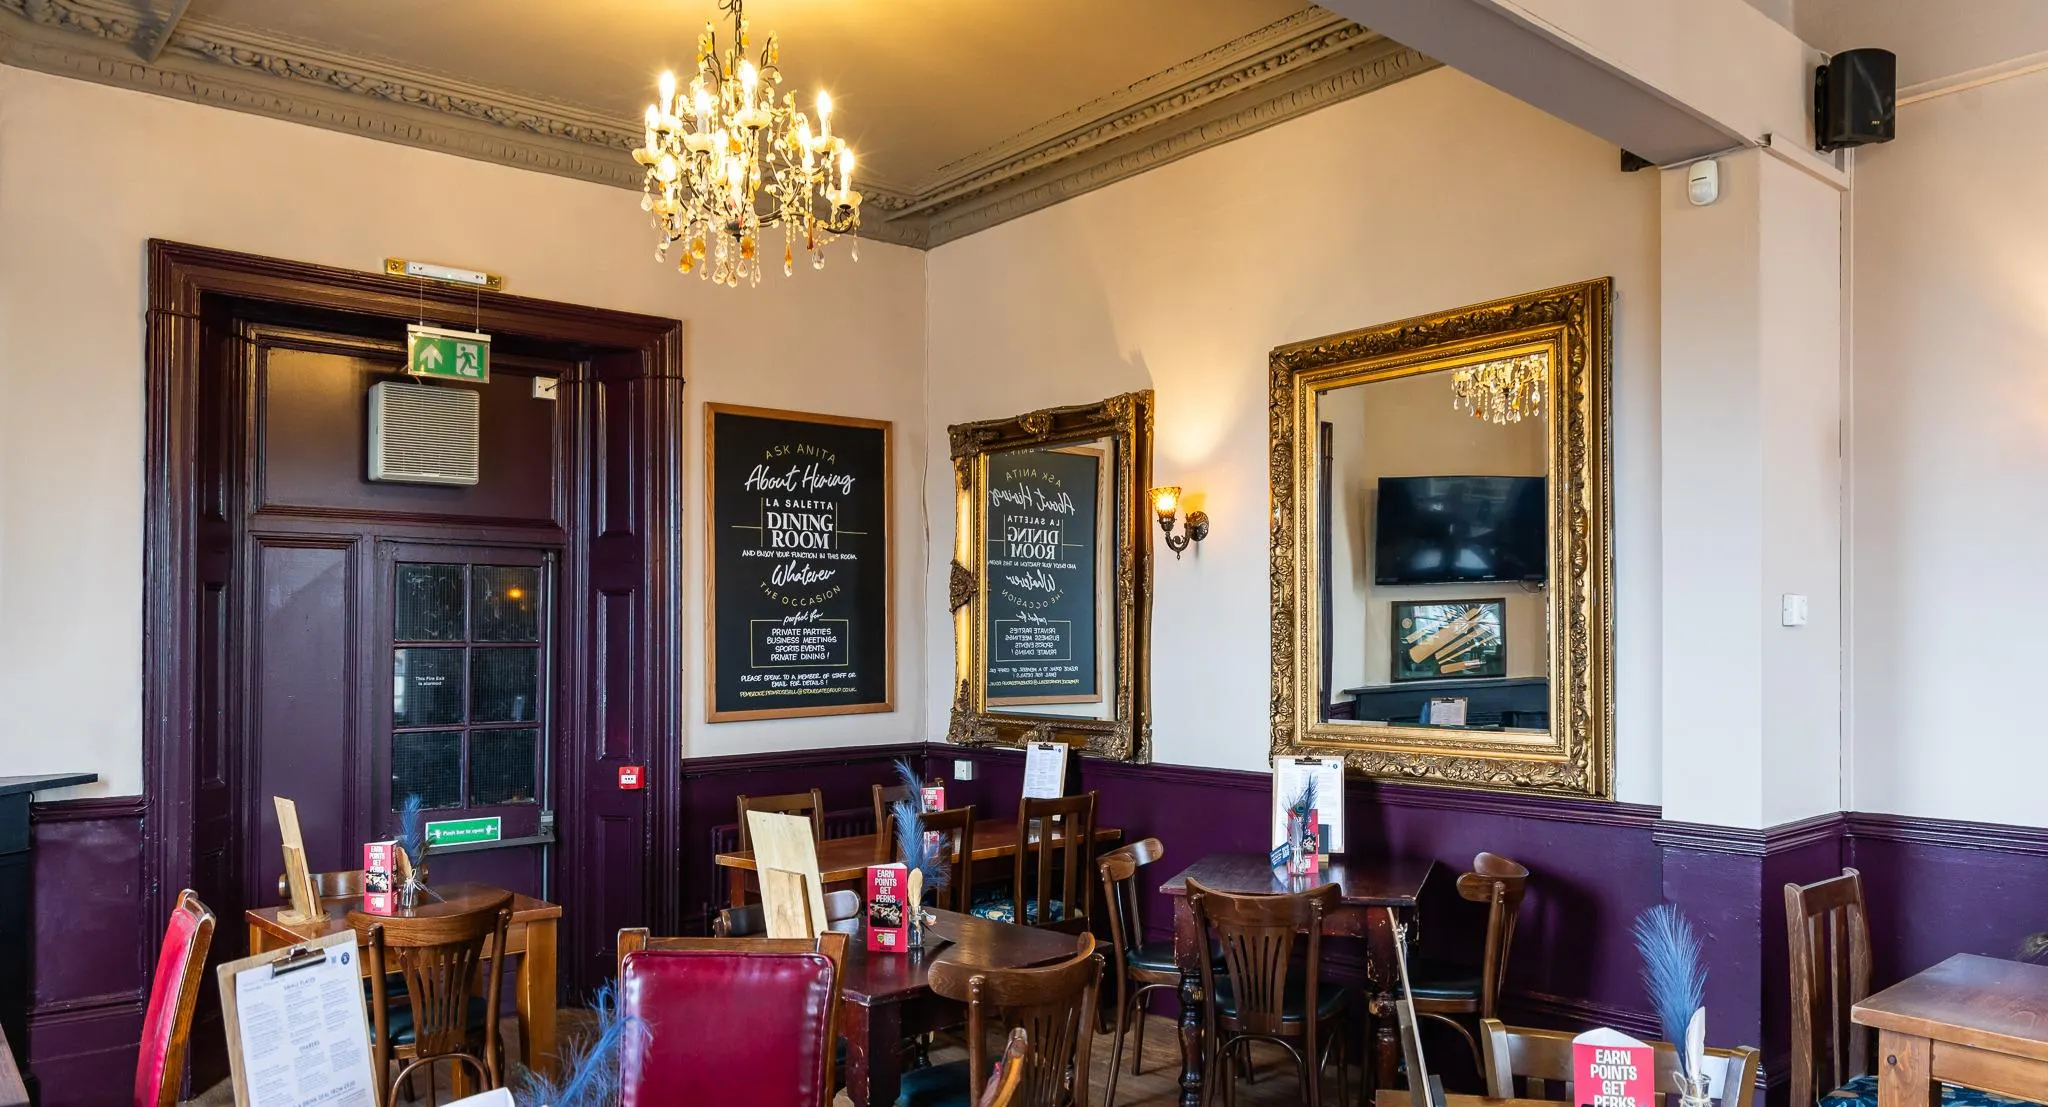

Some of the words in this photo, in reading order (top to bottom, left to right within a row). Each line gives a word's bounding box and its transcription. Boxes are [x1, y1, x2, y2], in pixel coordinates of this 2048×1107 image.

[766, 444, 790, 460] ASK
[797, 443, 836, 465] ANITA
[744, 464, 800, 492] About
[802, 462, 856, 495] Hiring
[766, 498, 780, 507] LA
[785, 499, 834, 511] SALETTA
[767, 512, 834, 532] DINING
[772, 530, 829, 549] ROOM
[742, 549, 756, 558] AND
[757, 550, 775, 558] ENJOY
[776, 551, 791, 559] YOUR
[791, 551, 818, 559] FUNCTION
[771, 560, 836, 587] Whatever
[760, 582, 778, 600] THE
[781, 585, 841, 607] OCCASION
[783, 611, 809, 626] perfect
[809, 609, 824, 622] for
[772, 628, 801, 636] PRIVATE
[803, 628, 832, 636] PARTIES
[766, 637, 800, 645] BUSINESS
[803, 636, 838, 644] MEETINGS
[775, 645, 800, 653] SPORTS
[770, 653, 797, 662] PRIVATE
[763, 674, 781, 682] SPEAK
[797, 673, 821, 681] MEMBER
[877, 869, 895, 878] EARN
[874, 878, 897, 887] POINTS
[880, 887, 891, 895] GET
[876, 895, 896, 903] PERKS
[1595, 1049, 1631, 1065] EARN
[1590, 1064, 1637, 1081] POINTS
[1602, 1081, 1626, 1096] GET
[1593, 1095, 1636, 1107] PERKS
